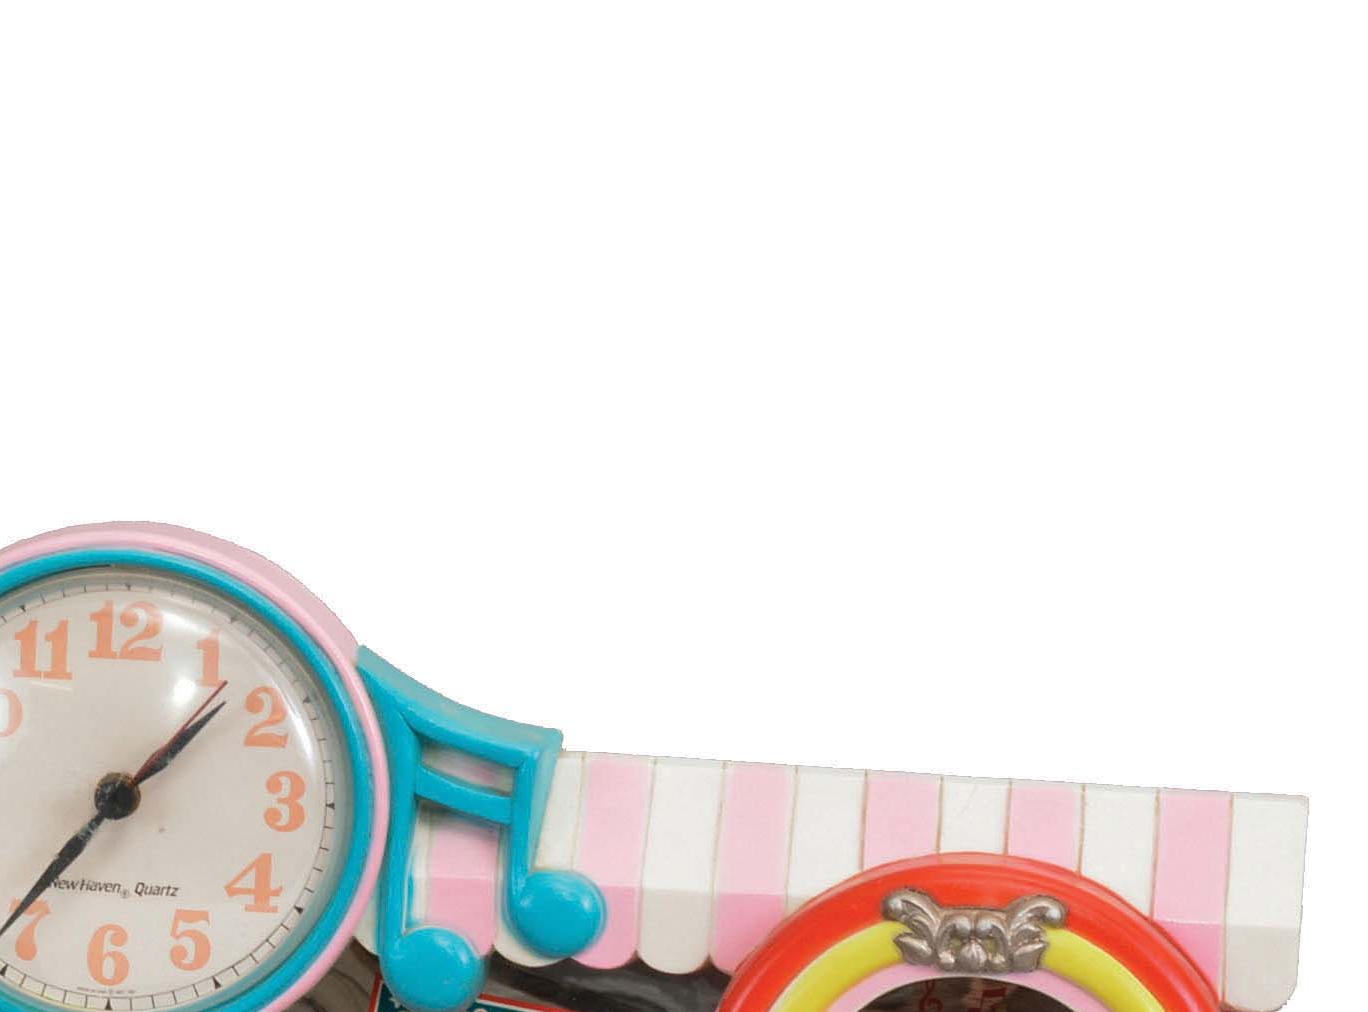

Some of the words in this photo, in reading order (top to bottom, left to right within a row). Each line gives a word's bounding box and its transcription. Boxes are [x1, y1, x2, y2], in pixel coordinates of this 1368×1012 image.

[12, 620, 73, 680] 11
[88, 600, 162, 660] 12
[196, 630, 227, 687] 1
[244, 686, 289, 747] 2
[264, 771, 306, 832] 3
[134, 881, 179, 896] Quartz
[224, 852, 283, 913] 4
[11, 899, 52, 960] 7
[87, 924, 130, 985] 6
[170, 909, 210, 970] 5
